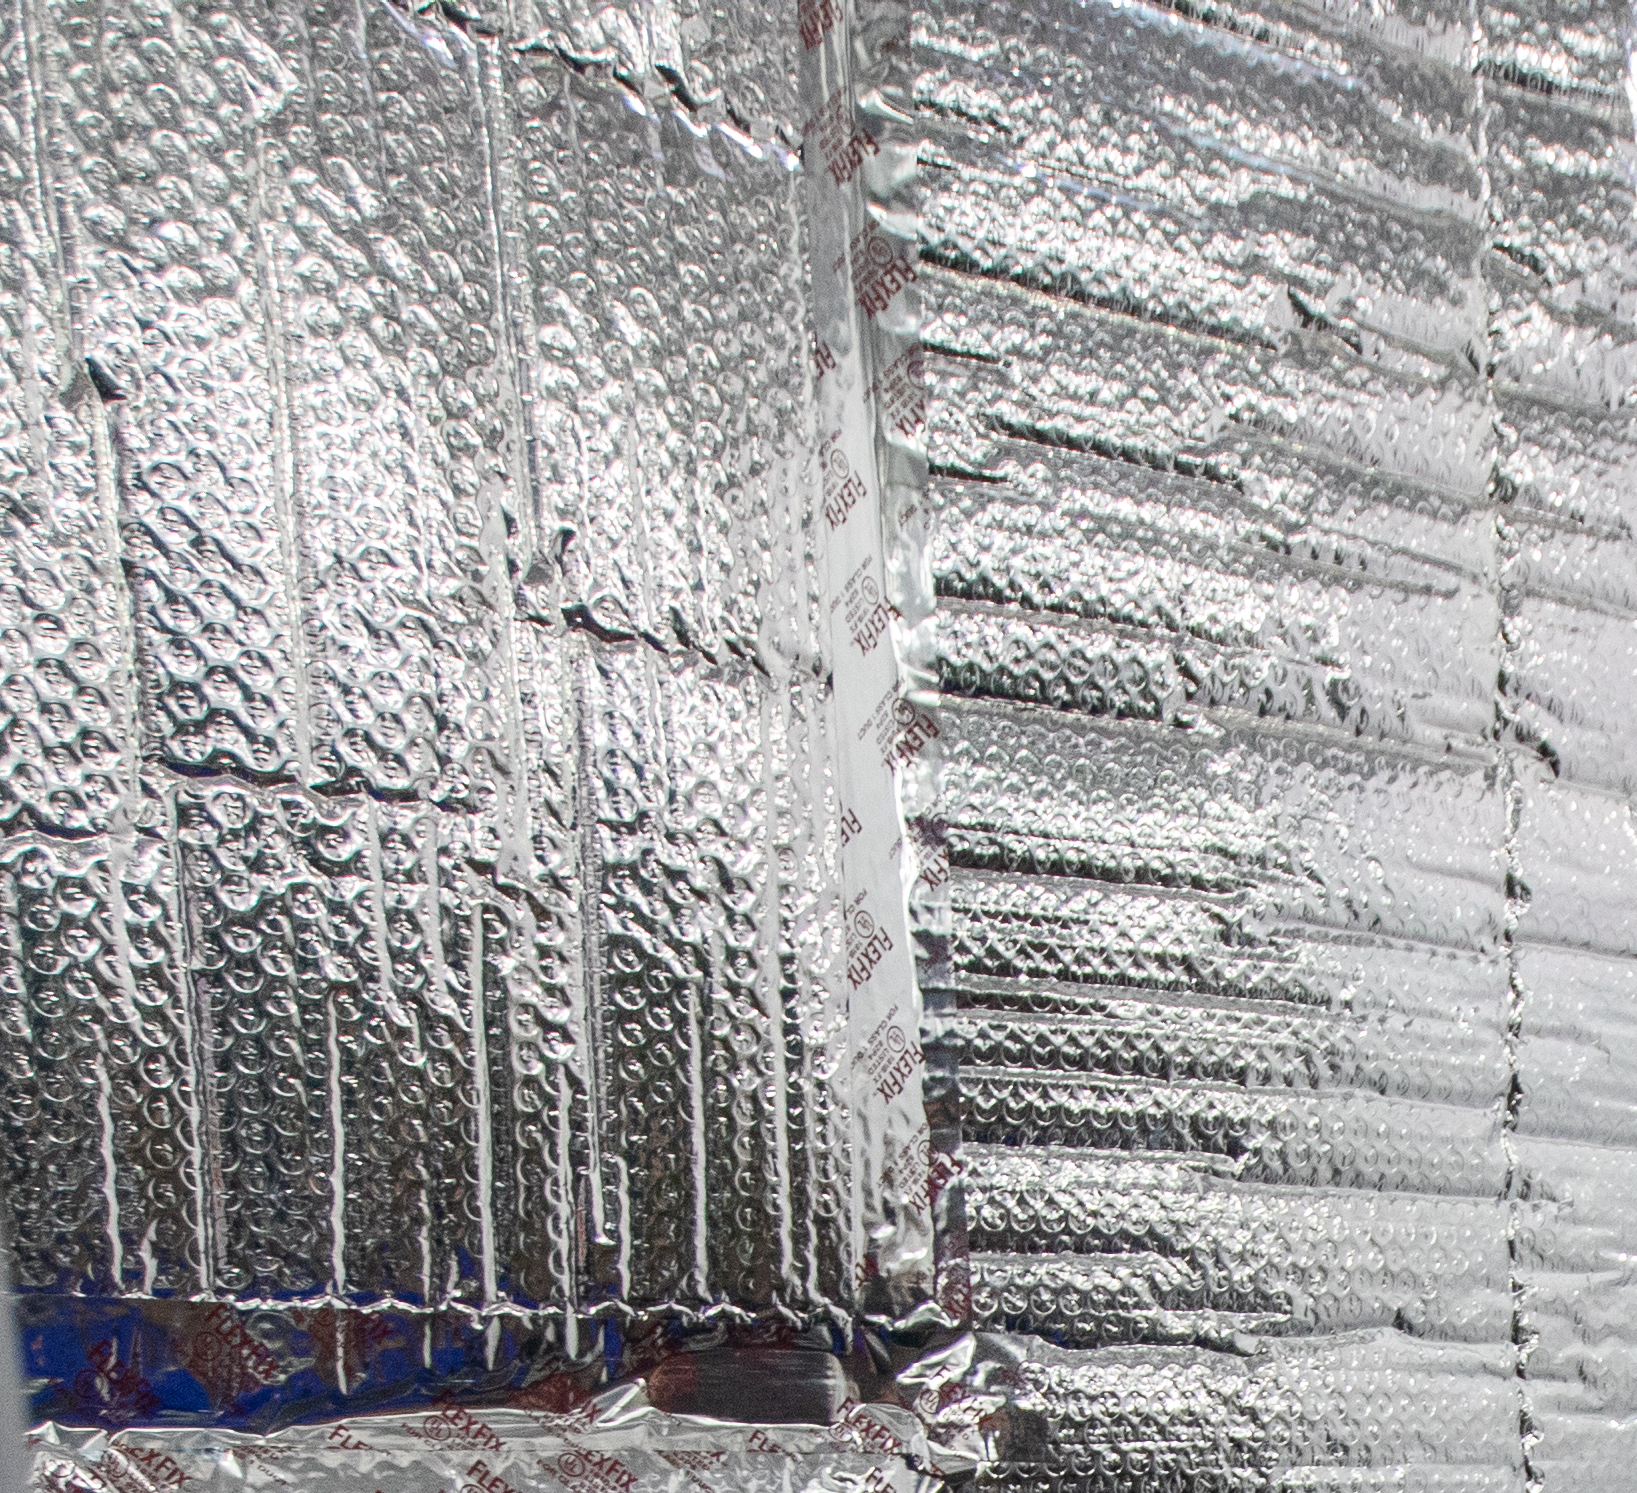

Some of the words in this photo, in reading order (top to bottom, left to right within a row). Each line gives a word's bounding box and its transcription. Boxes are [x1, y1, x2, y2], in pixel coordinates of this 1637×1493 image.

[821, 470, 869, 531] FLEXFIX
[844, 926, 895, 990] FLEXFIX
[875, 1040, 926, 1104] FLEXFIX
